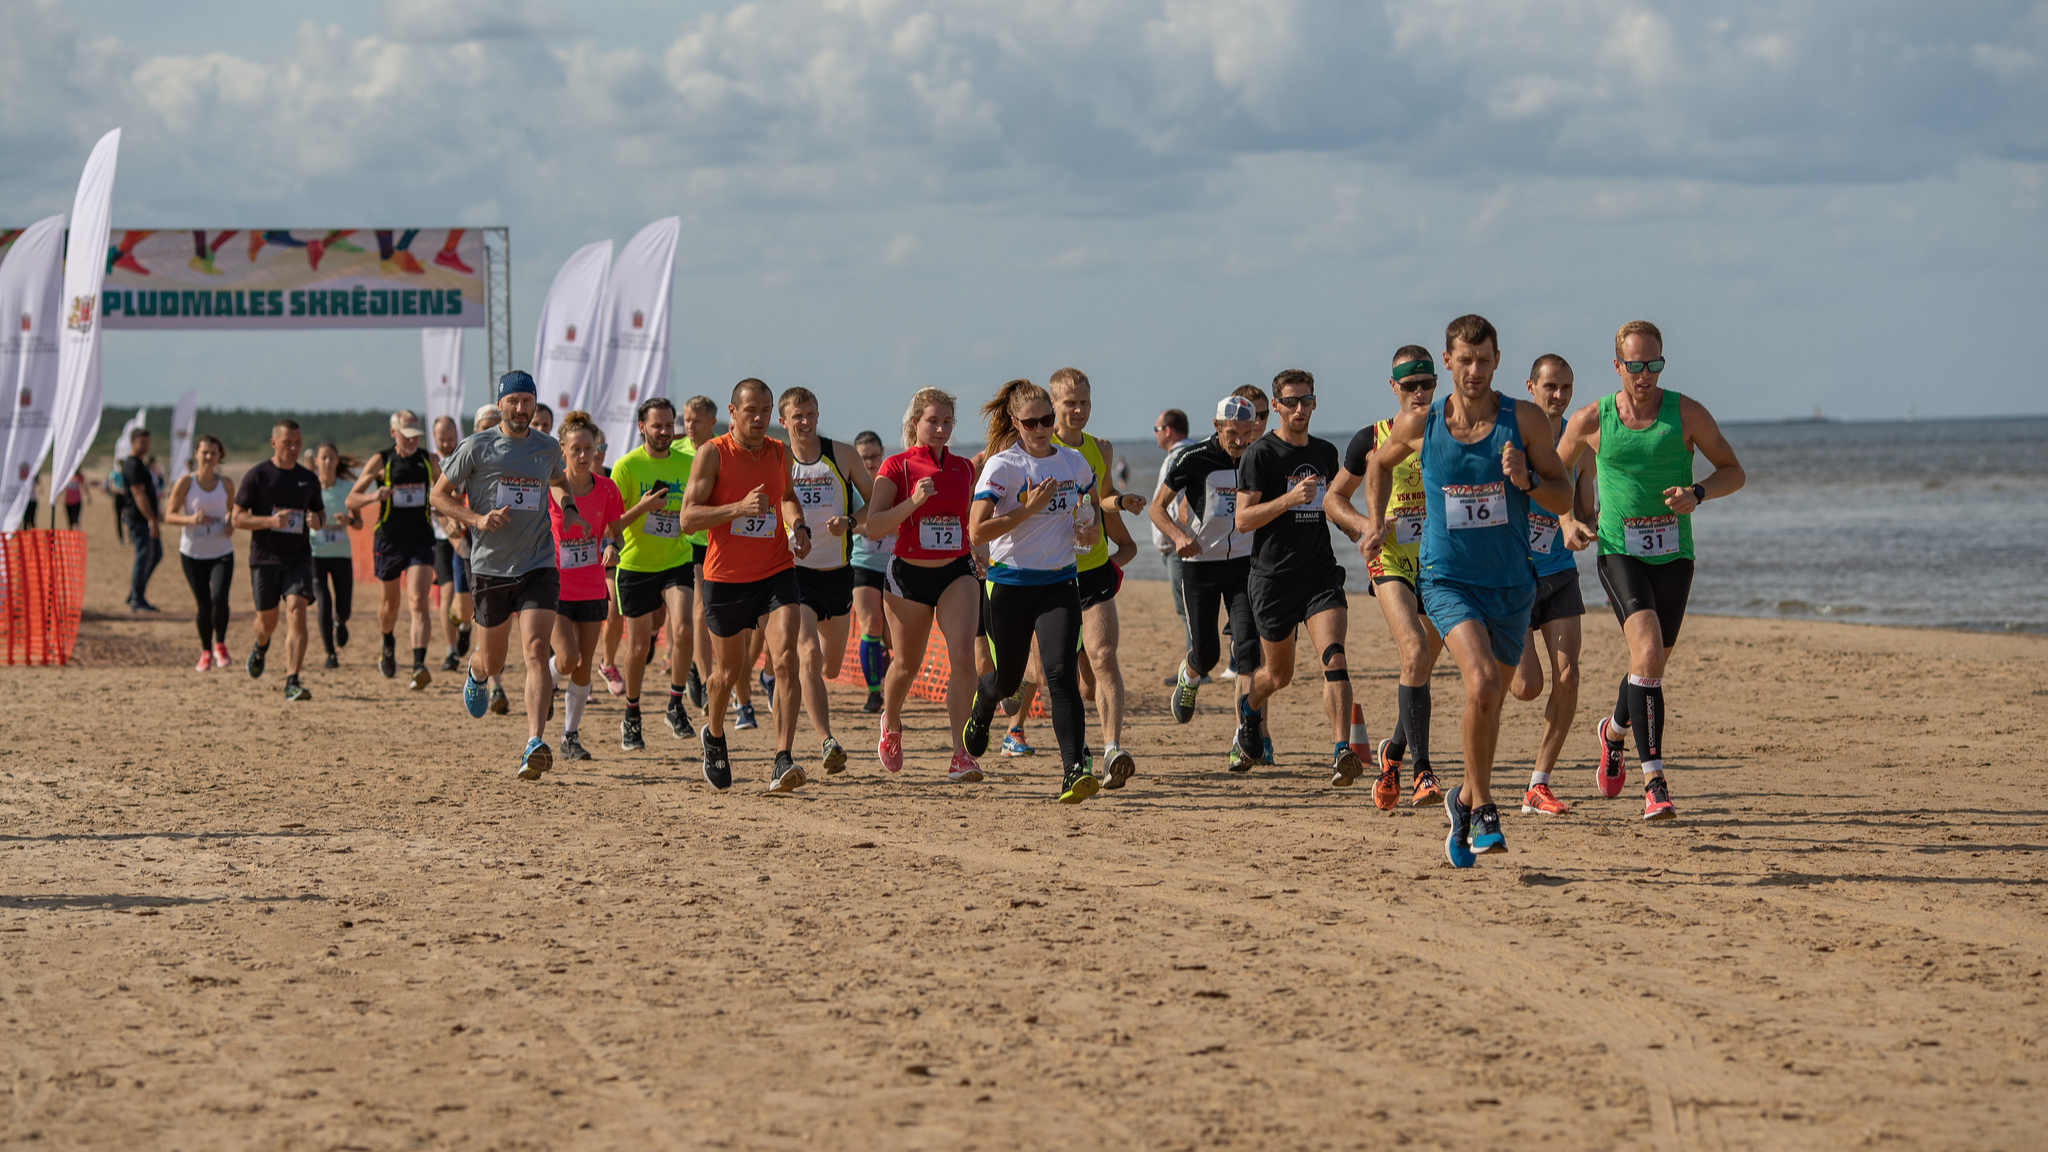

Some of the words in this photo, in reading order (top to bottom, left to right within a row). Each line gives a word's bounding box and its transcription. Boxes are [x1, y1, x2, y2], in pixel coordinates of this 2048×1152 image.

[102, 290, 283, 317] PLUDMALES
[290, 285, 463, 316] SKRĒJIENS
[514, 492, 524, 504] 3
[803, 491, 821, 504] 35
[1396, 493, 1411, 502] VSK
[1048, 497, 1067, 512] 34
[1465, 504, 1490, 521] 16
[655, 521, 672, 533] 33
[745, 519, 766, 532] 37
[935, 532, 953, 545] 12
[1642, 534, 1663, 550] 31
[573, 551, 588, 563] 15
